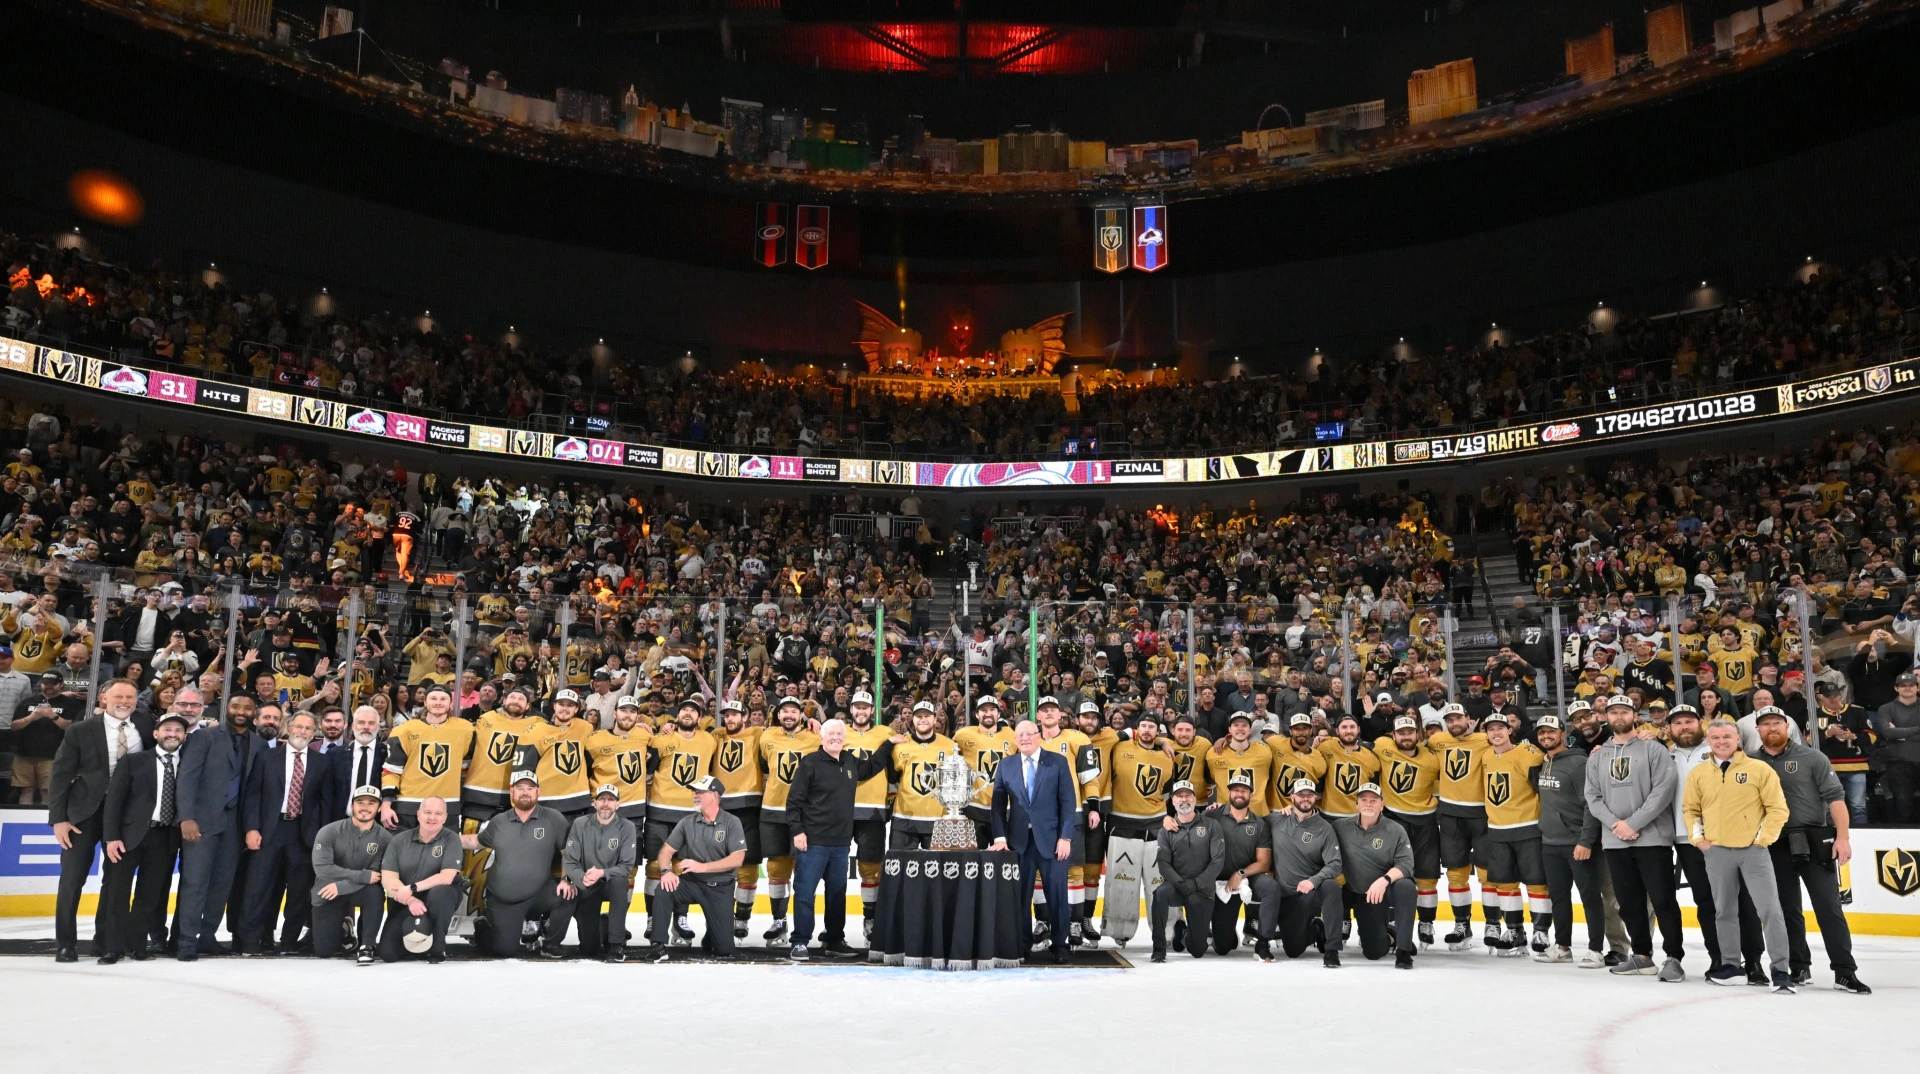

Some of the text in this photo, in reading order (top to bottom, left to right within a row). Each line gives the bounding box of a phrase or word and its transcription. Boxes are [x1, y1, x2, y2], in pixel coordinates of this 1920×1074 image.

[161, 379, 188, 398] 31
[1795, 368, 1916, 403] Forged in
[1823, 376, 1853, 387] PLAYOFFS
[202, 389, 241, 403] HITS
[257, 397, 286, 414] 29
[1595, 394, 1756, 435] 178462710128
[395, 420, 420, 438] 24
[569, 416, 611, 428] JESON
[430, 431, 465, 443] WINS
[431, 425, 466, 435] FACEOFF
[478, 431, 503, 447] 29
[1431, 426, 1539, 458] 51/49 RAFFLE
[592, 444, 622, 460] 0/1
[629, 449, 658, 458] POWER
[629, 455, 658, 464] PLAYS
[665, 453, 696, 470] 0/2
[778, 461, 796, 475] 11
[847, 464, 866, 478] 14
[1094, 462, 1106, 481] 1
[1115, 462, 1162, 474] FINAL
[398, 516, 413, 529] 92
[297, 612, 319, 634] EGA
[1525, 631, 1541, 645] 27
[969, 642, 989, 658] USA
[568, 658, 591, 676] 24
[1373, 663, 1390, 679] VEG
[1003, 741, 1010, 752] C
[1060, 742, 1068, 753] A
[938, 750, 945, 762] A
